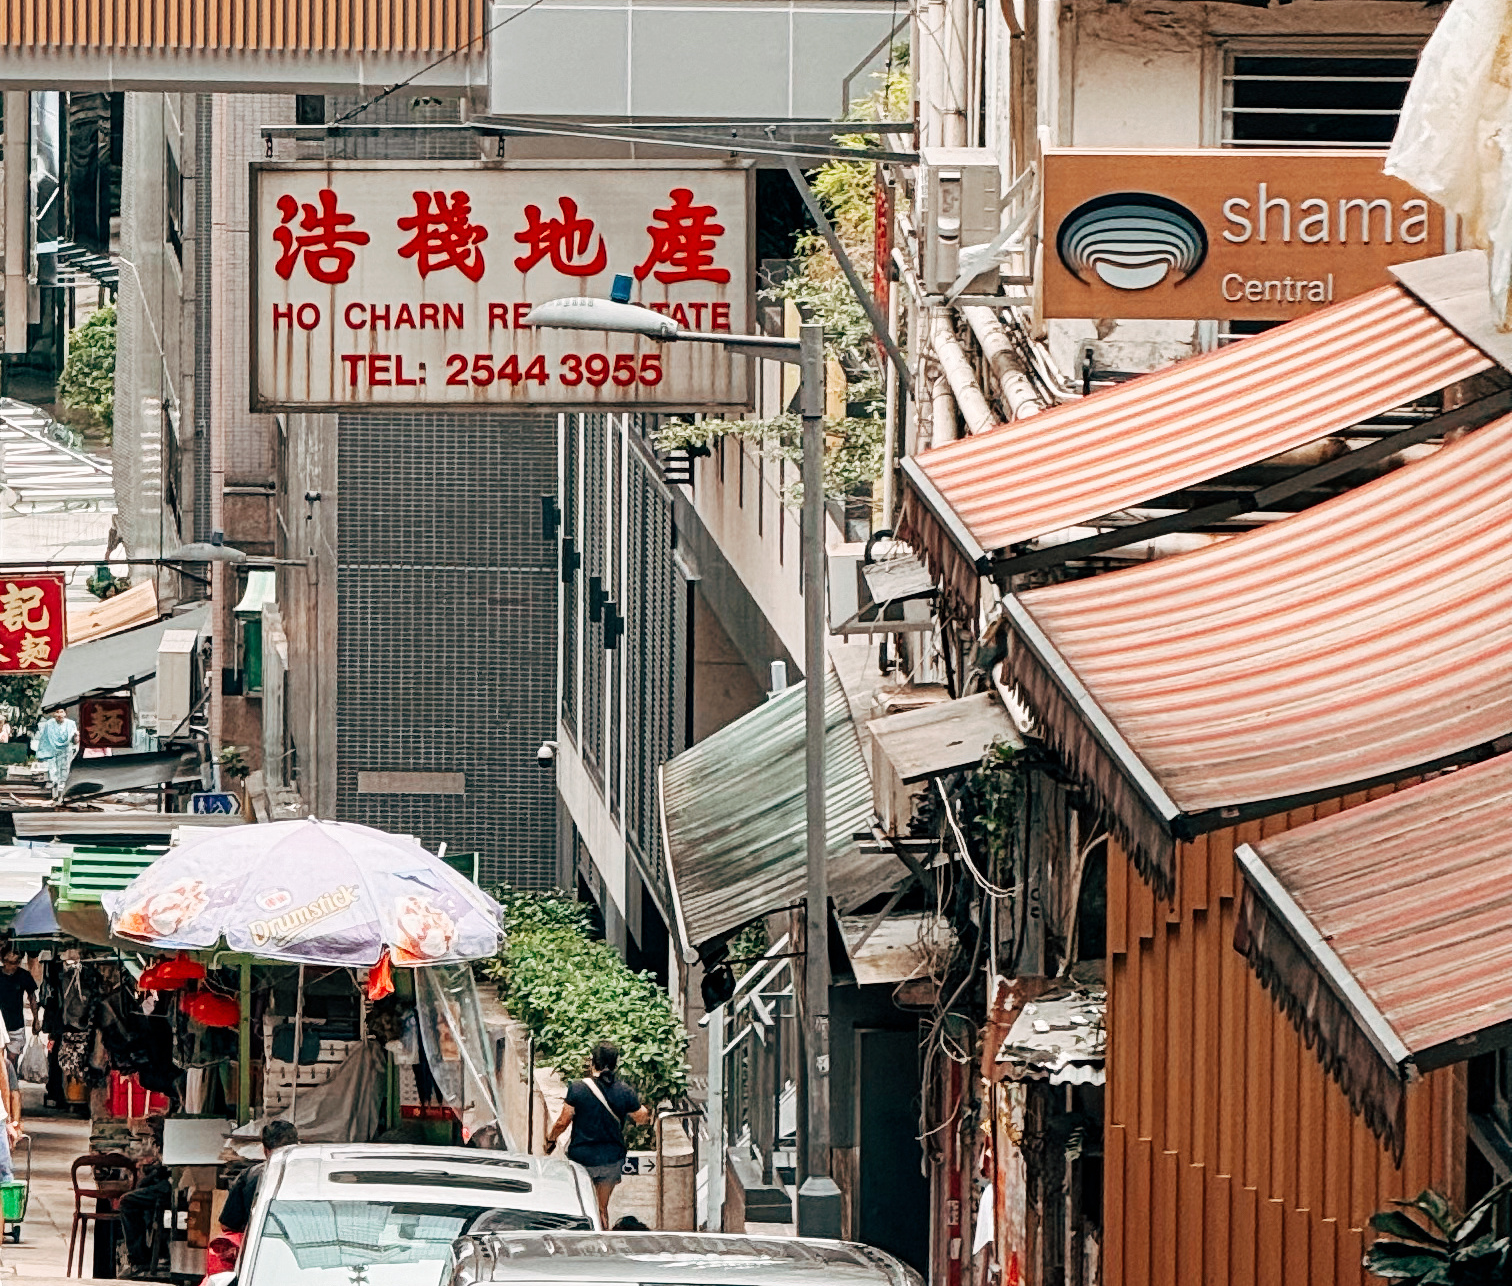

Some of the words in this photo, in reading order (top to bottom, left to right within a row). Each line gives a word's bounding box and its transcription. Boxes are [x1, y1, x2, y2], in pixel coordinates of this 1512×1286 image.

[1221, 182, 1429, 244] shama
[1221, 273, 1334, 303] Central
[273, 303, 321, 331] HO
[345, 303, 465, 330] CHARN
[489, 303, 533, 330] RE
[342, 354, 427, 387] TEL:
[446, 354, 551, 387] 2544
[559, 354, 664, 387] 3955
[248, 884, 360, 947] Drumstick
